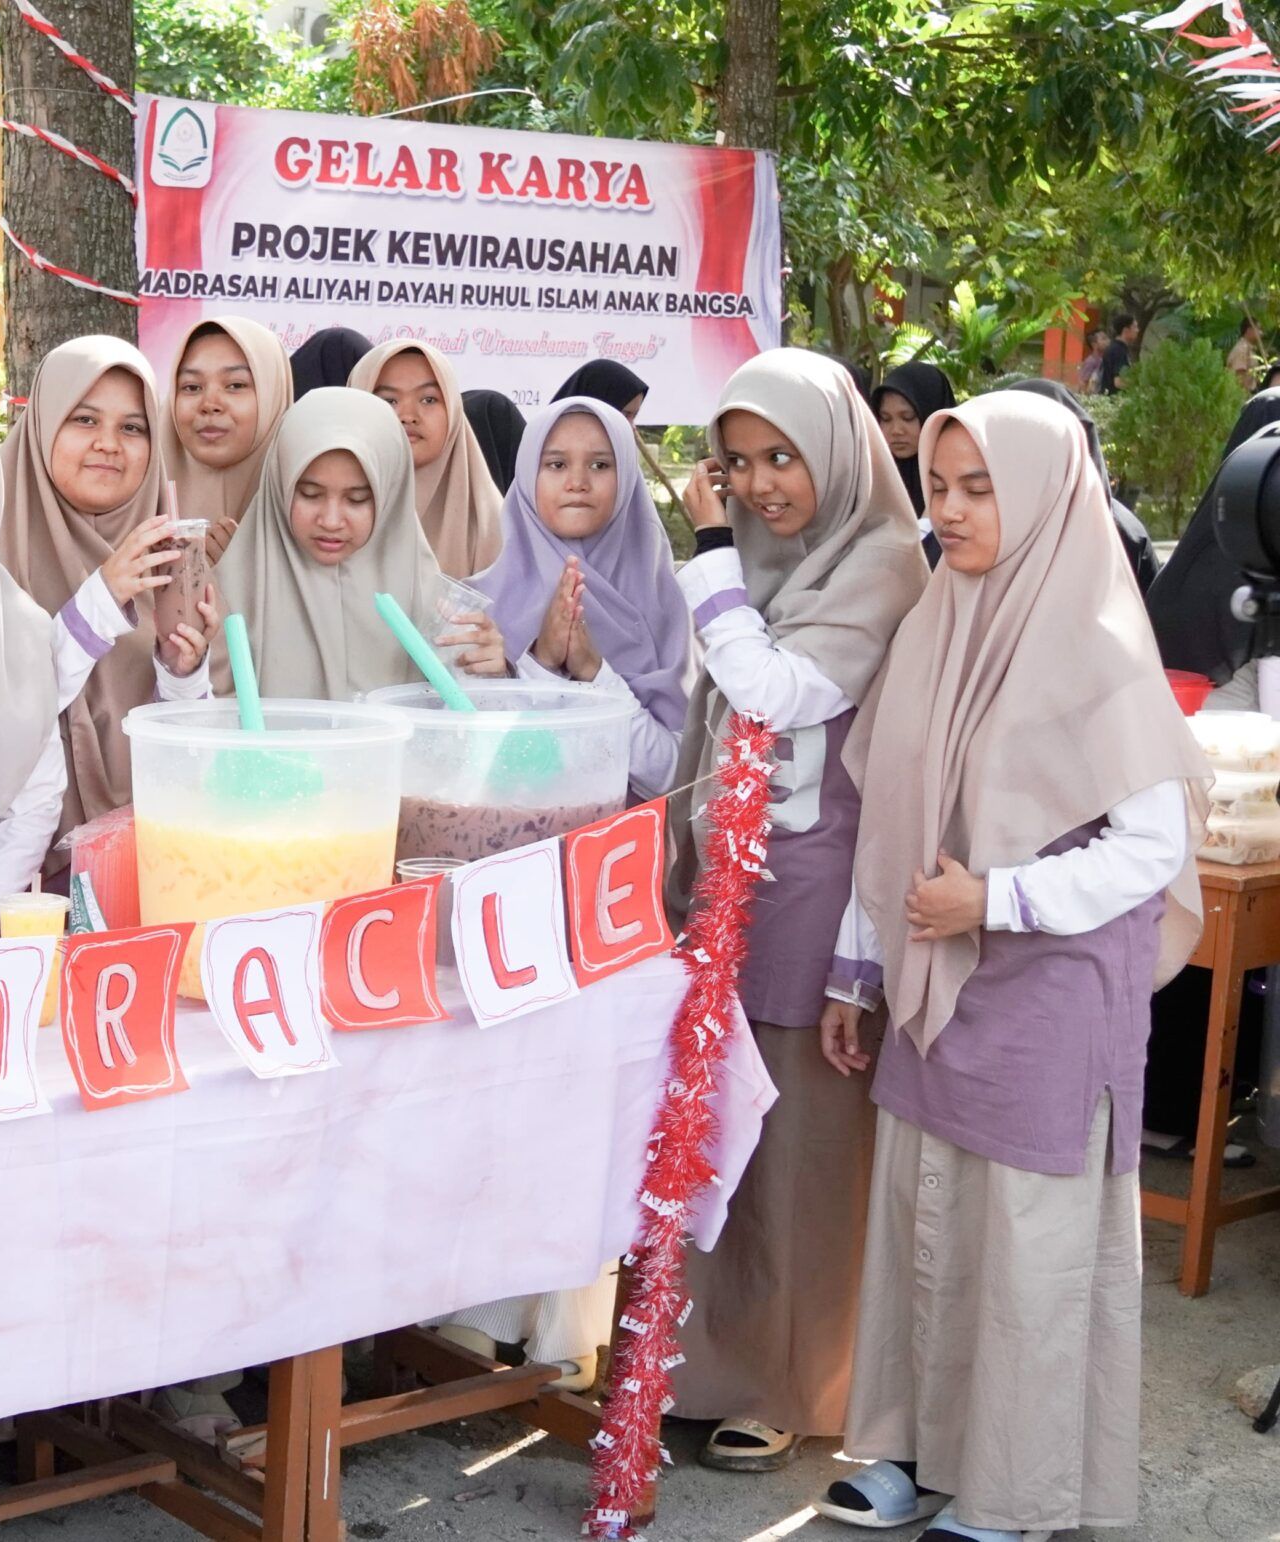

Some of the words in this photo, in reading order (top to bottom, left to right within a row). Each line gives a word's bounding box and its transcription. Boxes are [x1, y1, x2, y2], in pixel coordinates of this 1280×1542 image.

[273, 135, 462, 194] GELAR
[477, 151, 651, 205] KARYA
[231, 222, 377, 263] PROJEK
[387, 230, 678, 277] KEWIRAUSAHAAN
[284, 277, 371, 301] ALIYAH
[378, 281, 455, 305] DAYAH
[461, 284, 531, 307] RUHUL
[537, 288, 598, 310] ISLAM
[603, 291, 661, 312] ANAK
[665, 293, 754, 315] BANGSA
[512, 389, 540, 406] 2024
